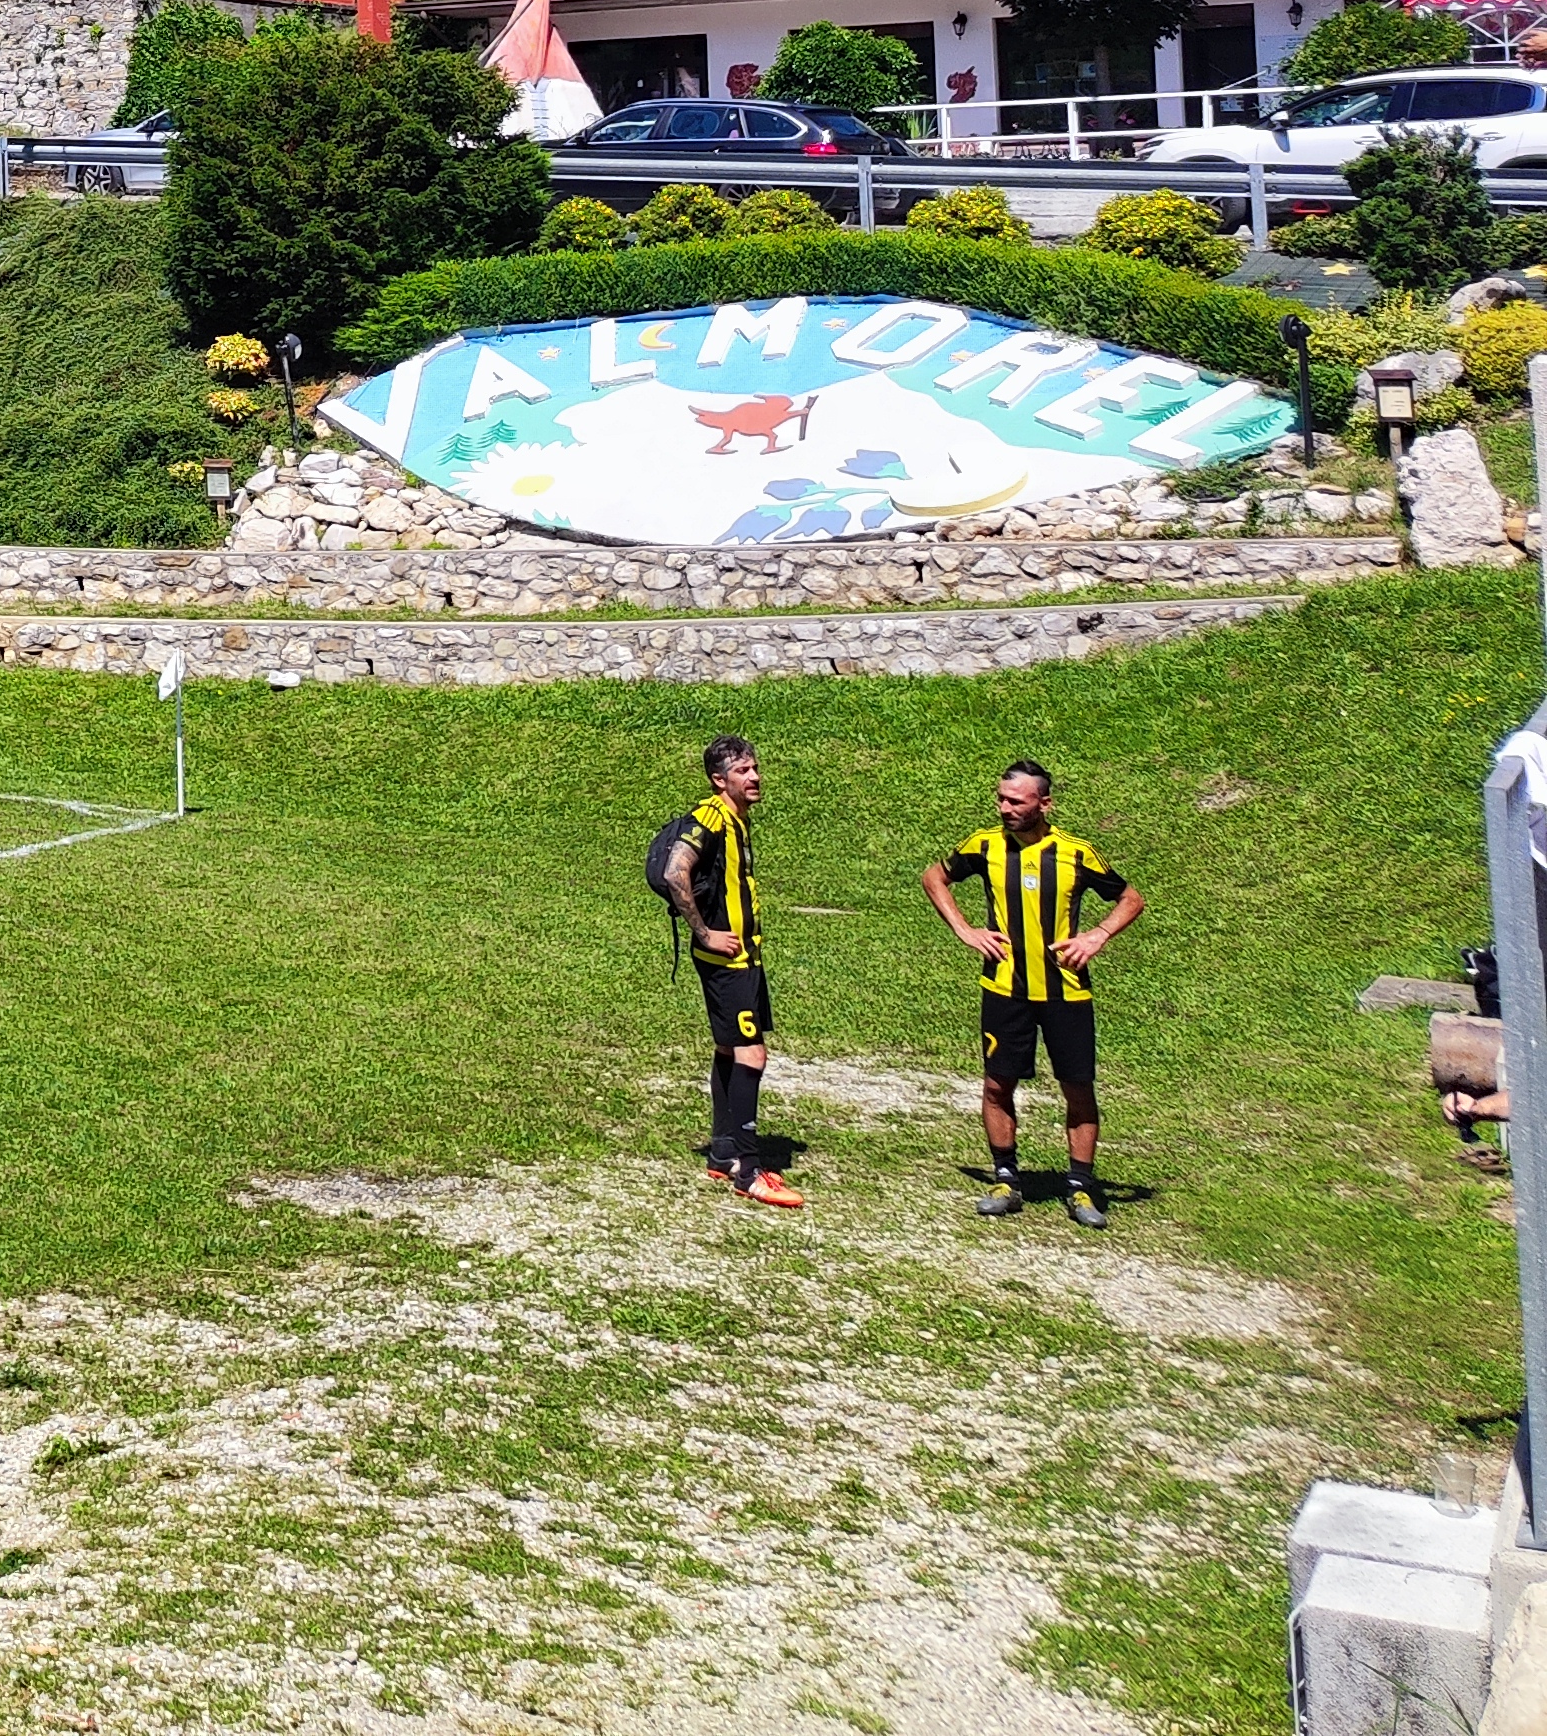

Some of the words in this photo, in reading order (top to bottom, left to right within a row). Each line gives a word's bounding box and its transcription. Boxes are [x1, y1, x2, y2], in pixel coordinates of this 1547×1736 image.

[317, 296, 1260, 466] VALMOREL
[738, 1010, 757, 1038] 6
[984, 1031, 997, 1058] 7
